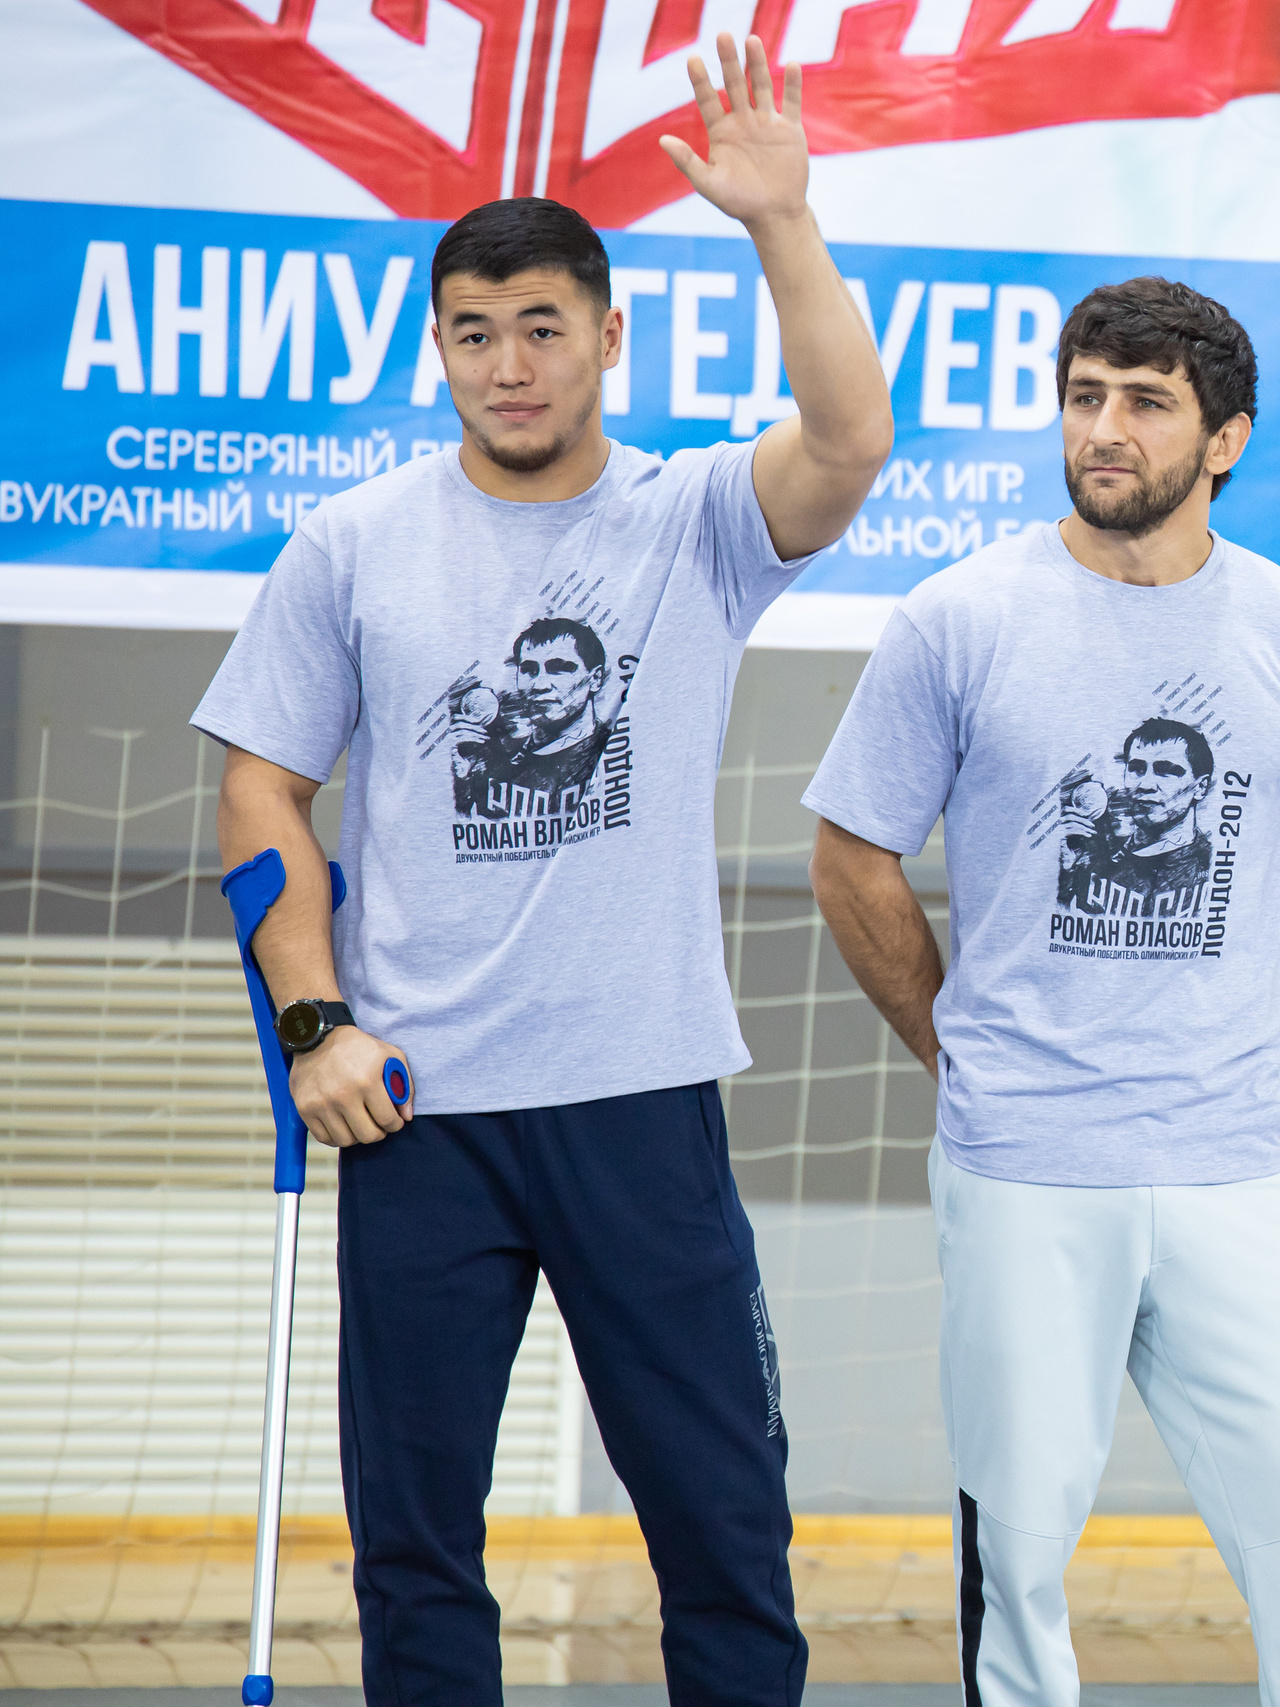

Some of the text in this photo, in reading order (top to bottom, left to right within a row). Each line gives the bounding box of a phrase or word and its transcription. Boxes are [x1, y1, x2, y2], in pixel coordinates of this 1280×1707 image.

[106, 424, 397, 479] СЕРЕБРЯНЫЙ
[943, 461, 1024, 504] ИГР.
[0, 480, 252, 533] ВУКРАТНЫЙ
[452, 820, 528, 850] РОМАН
[534, 797, 601, 847] ВЛОВ
[455, 851, 503, 864] ДВУКРАТНЫЙ
[504, 849, 551, 862] ПОБЕДИТЕЛЬ
[1201, 770, 1252, 958] ЛОНДОН-2012
[1049, 942, 1096, 958] ДВУКРАТНЫЙ
[1097, 949, 1140, 961] ПОБЕДИТЕЛЬ
[1140, 949, 1189, 961] ОЛИМПИЙСКИХ
[1050, 913, 1204, 948] РОМАН ВЛАСОВ
[749, 1291, 768, 1362] EMPORIO
